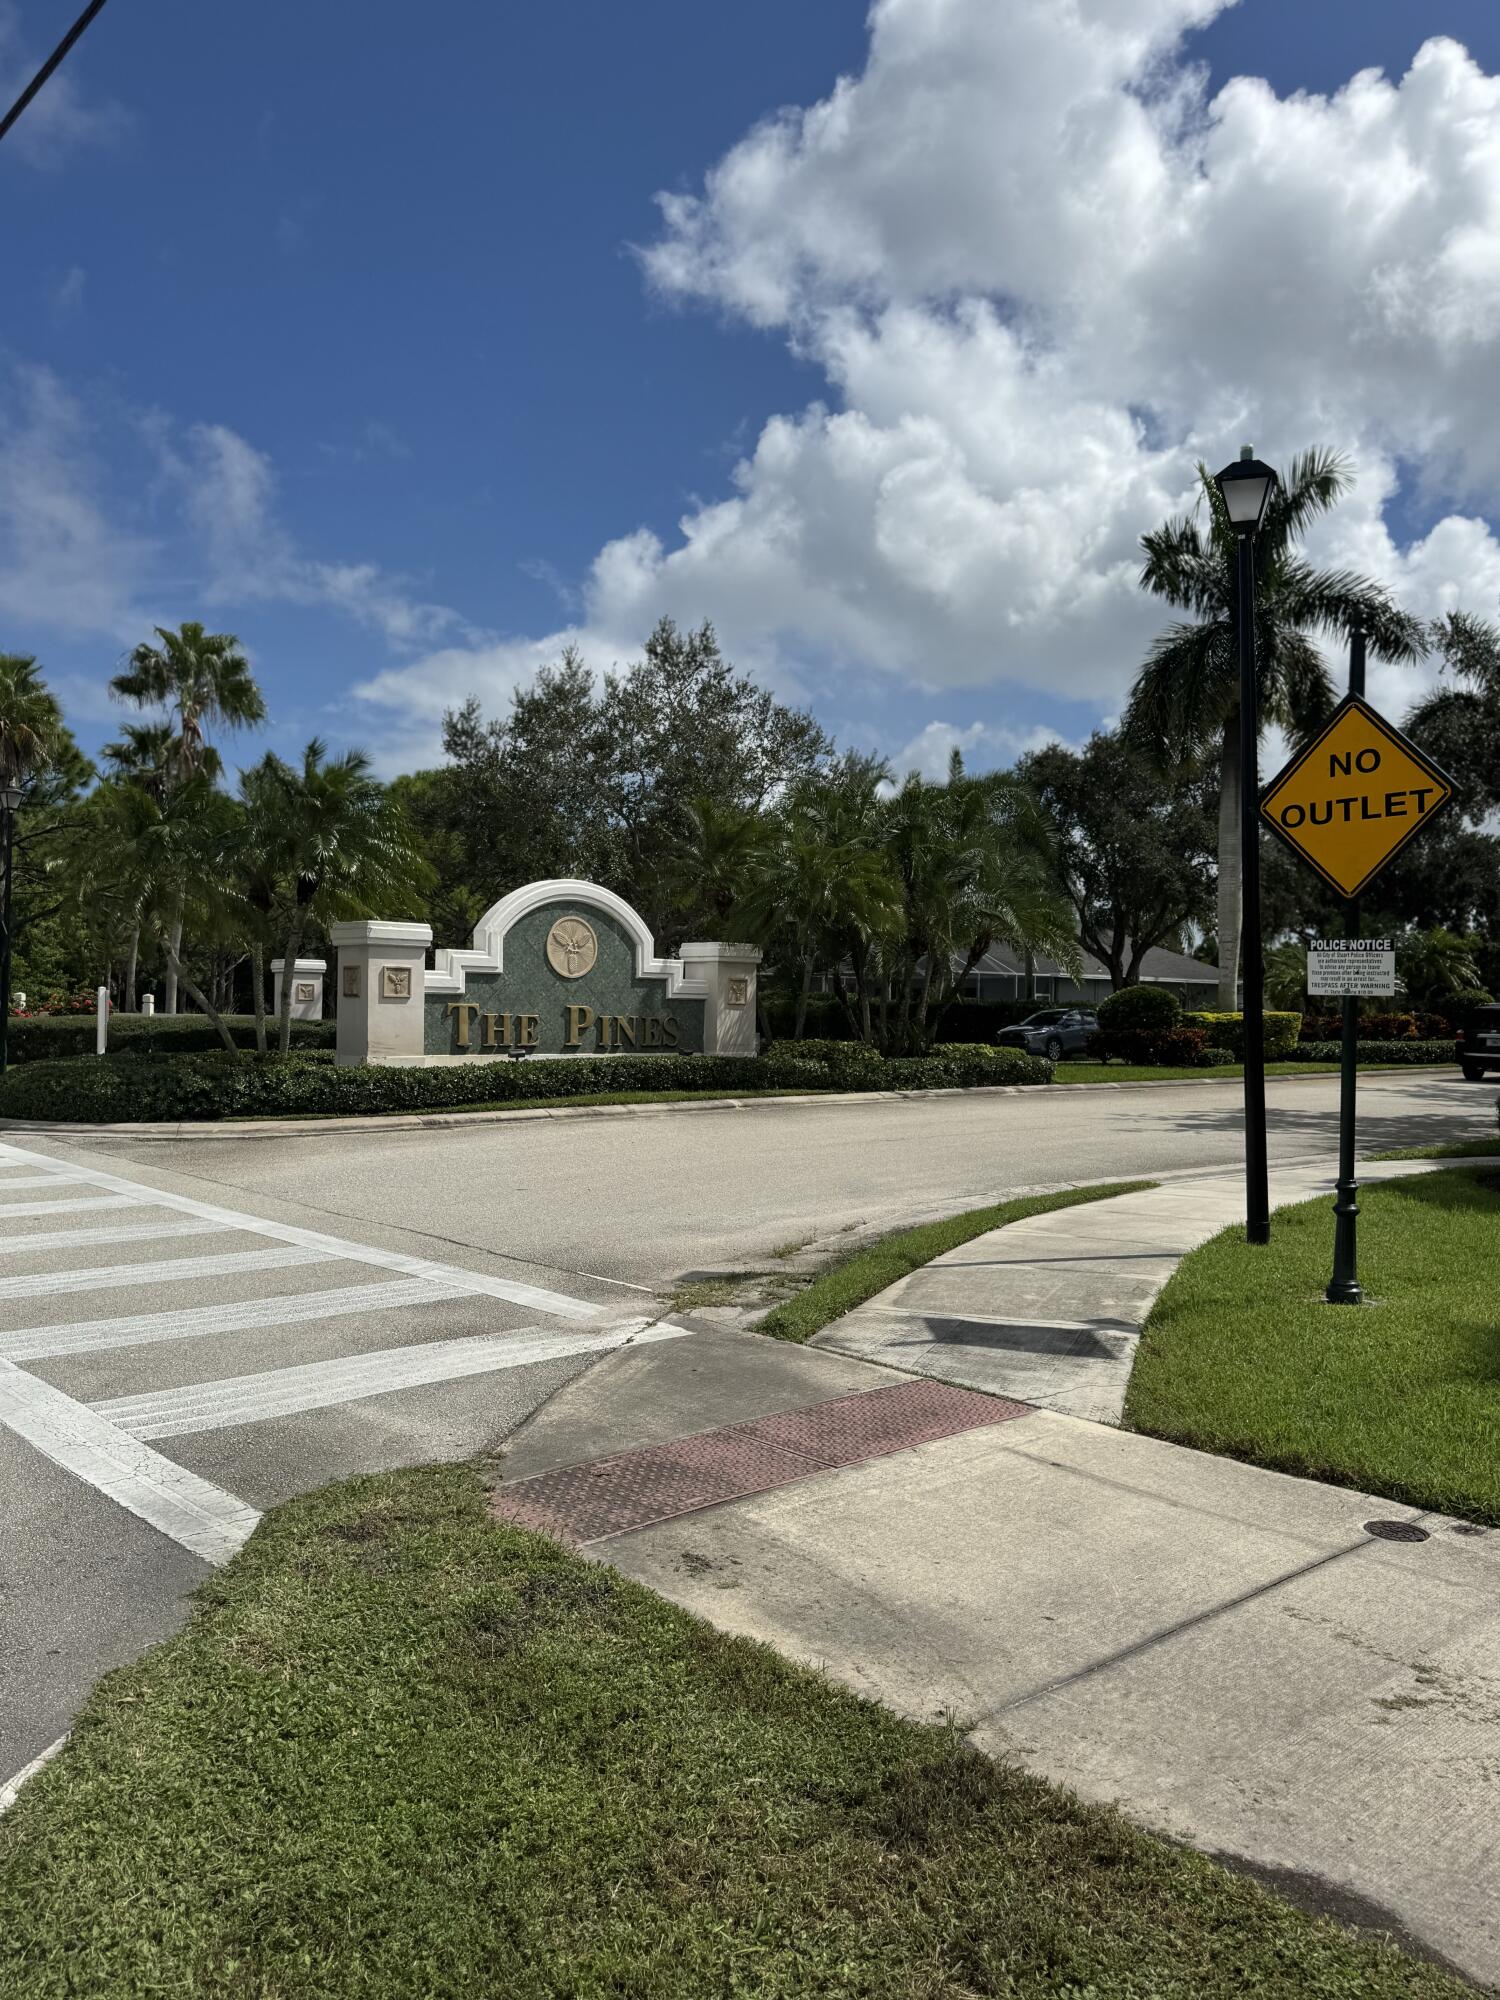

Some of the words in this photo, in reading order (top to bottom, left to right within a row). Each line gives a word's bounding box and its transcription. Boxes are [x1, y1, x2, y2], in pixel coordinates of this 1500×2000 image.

[1329, 748, 1382, 778] NO
[1280, 788, 1434, 829] OUTLET
[1310, 940, 1346, 950] POLICE
[1349, 939, 1391, 950] NOTICE
